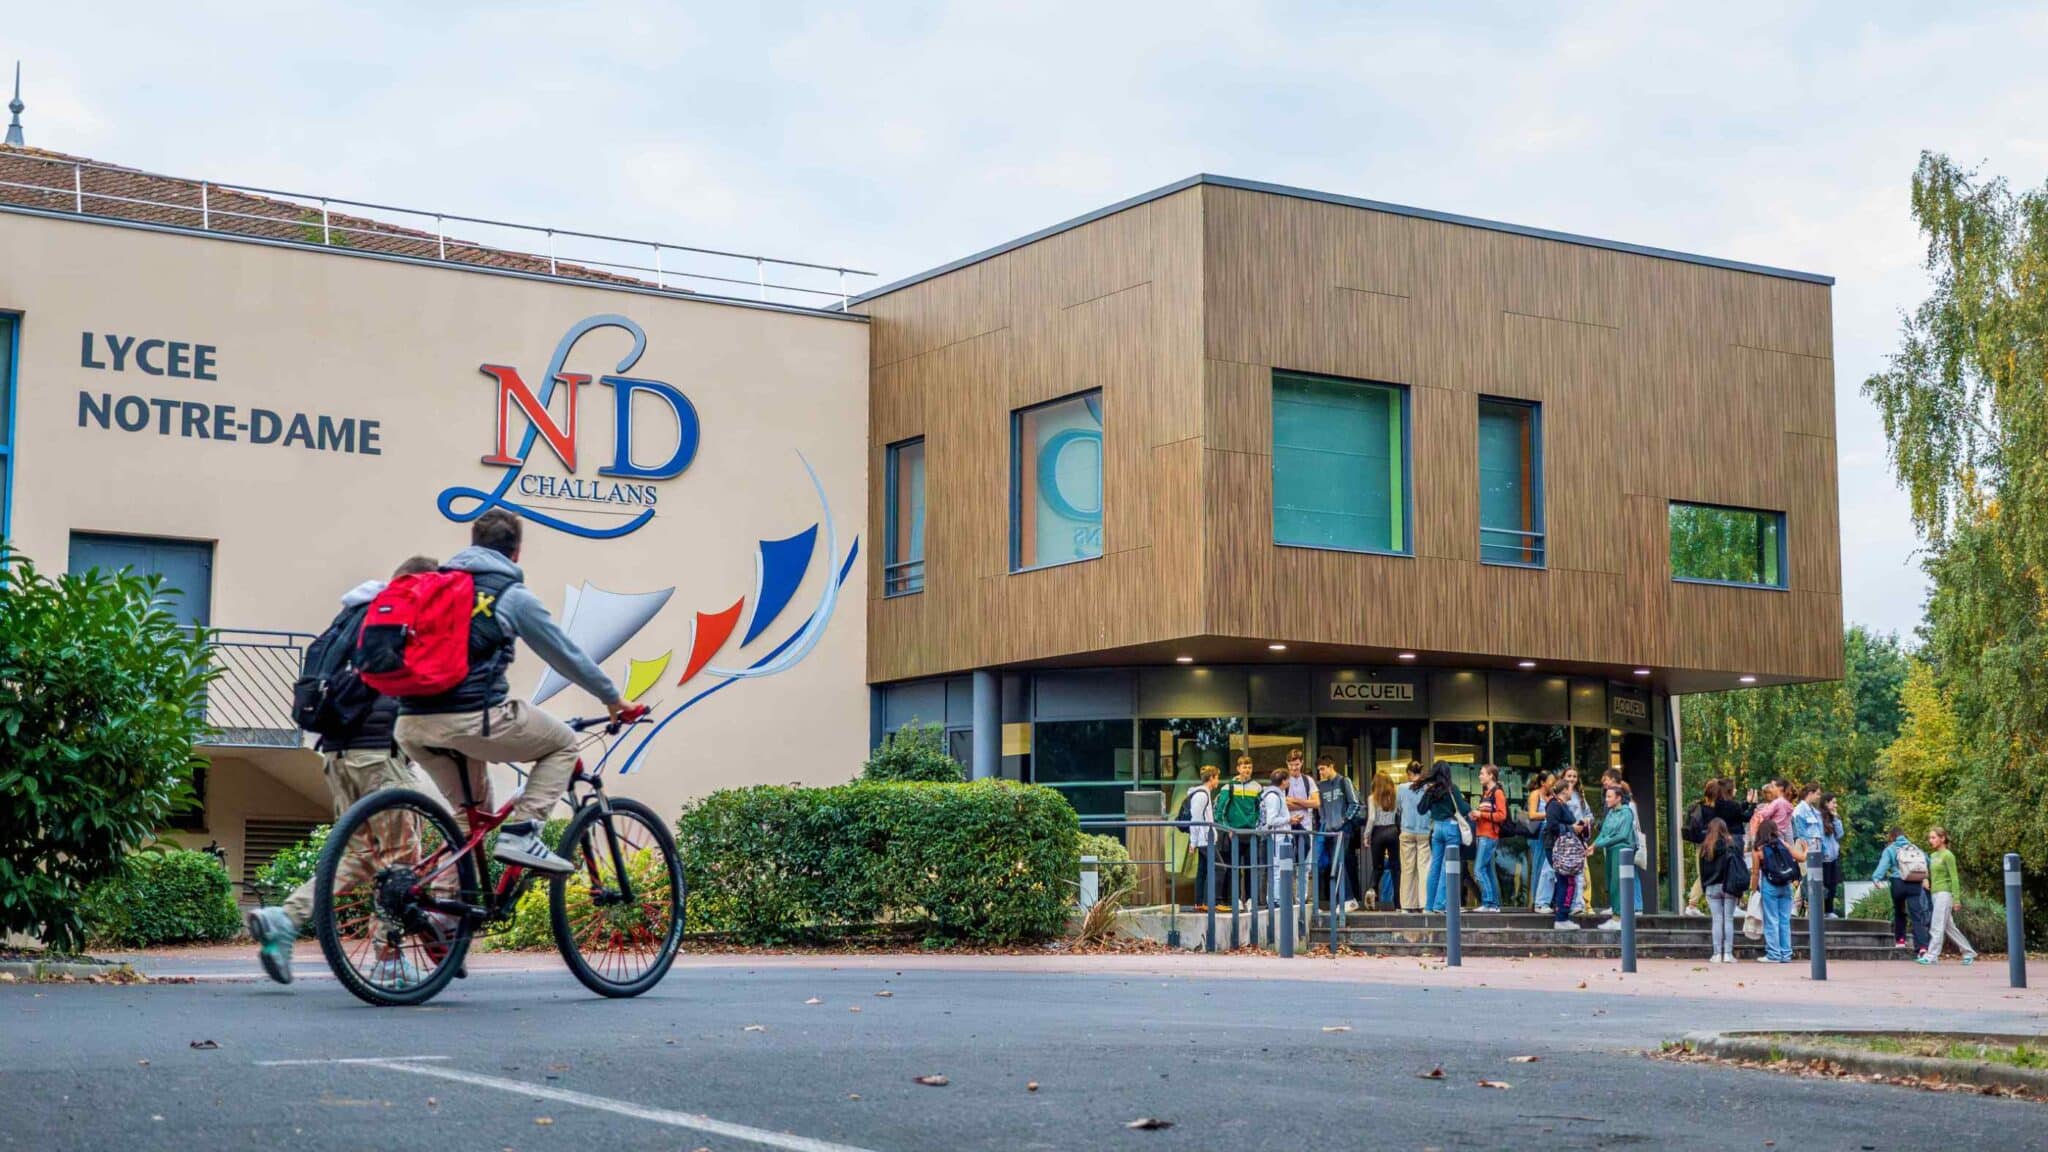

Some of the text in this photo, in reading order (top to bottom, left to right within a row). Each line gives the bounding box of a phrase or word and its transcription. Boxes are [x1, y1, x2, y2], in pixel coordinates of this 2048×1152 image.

[81, 331, 218, 381] LYCEE
[78, 390, 382, 456] NOTRE-DAME
[519, 474, 657, 506] CHALLANS
[1332, 684, 1412, 699] ACCUEIL
